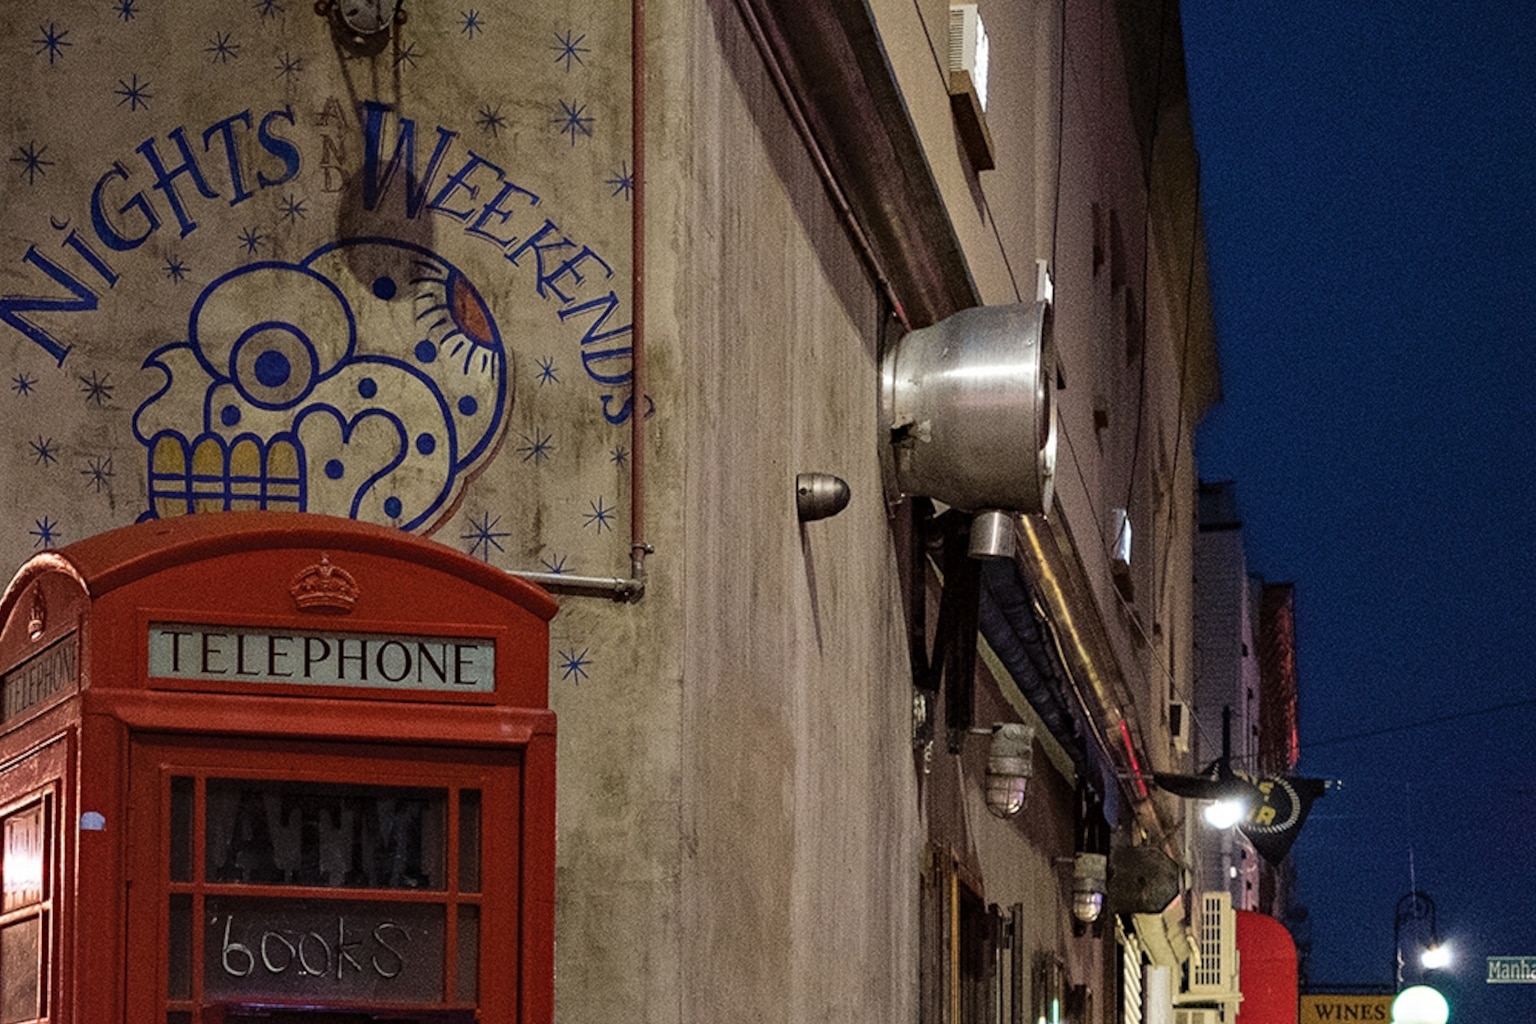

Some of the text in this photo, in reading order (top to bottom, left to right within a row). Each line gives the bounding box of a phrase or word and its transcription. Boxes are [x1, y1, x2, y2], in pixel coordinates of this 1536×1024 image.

[359, 100, 655, 425] WEEKENDS
[159, 629, 481, 686] TELEPHONE
[1315, 1003, 1386, 1021] WINES
